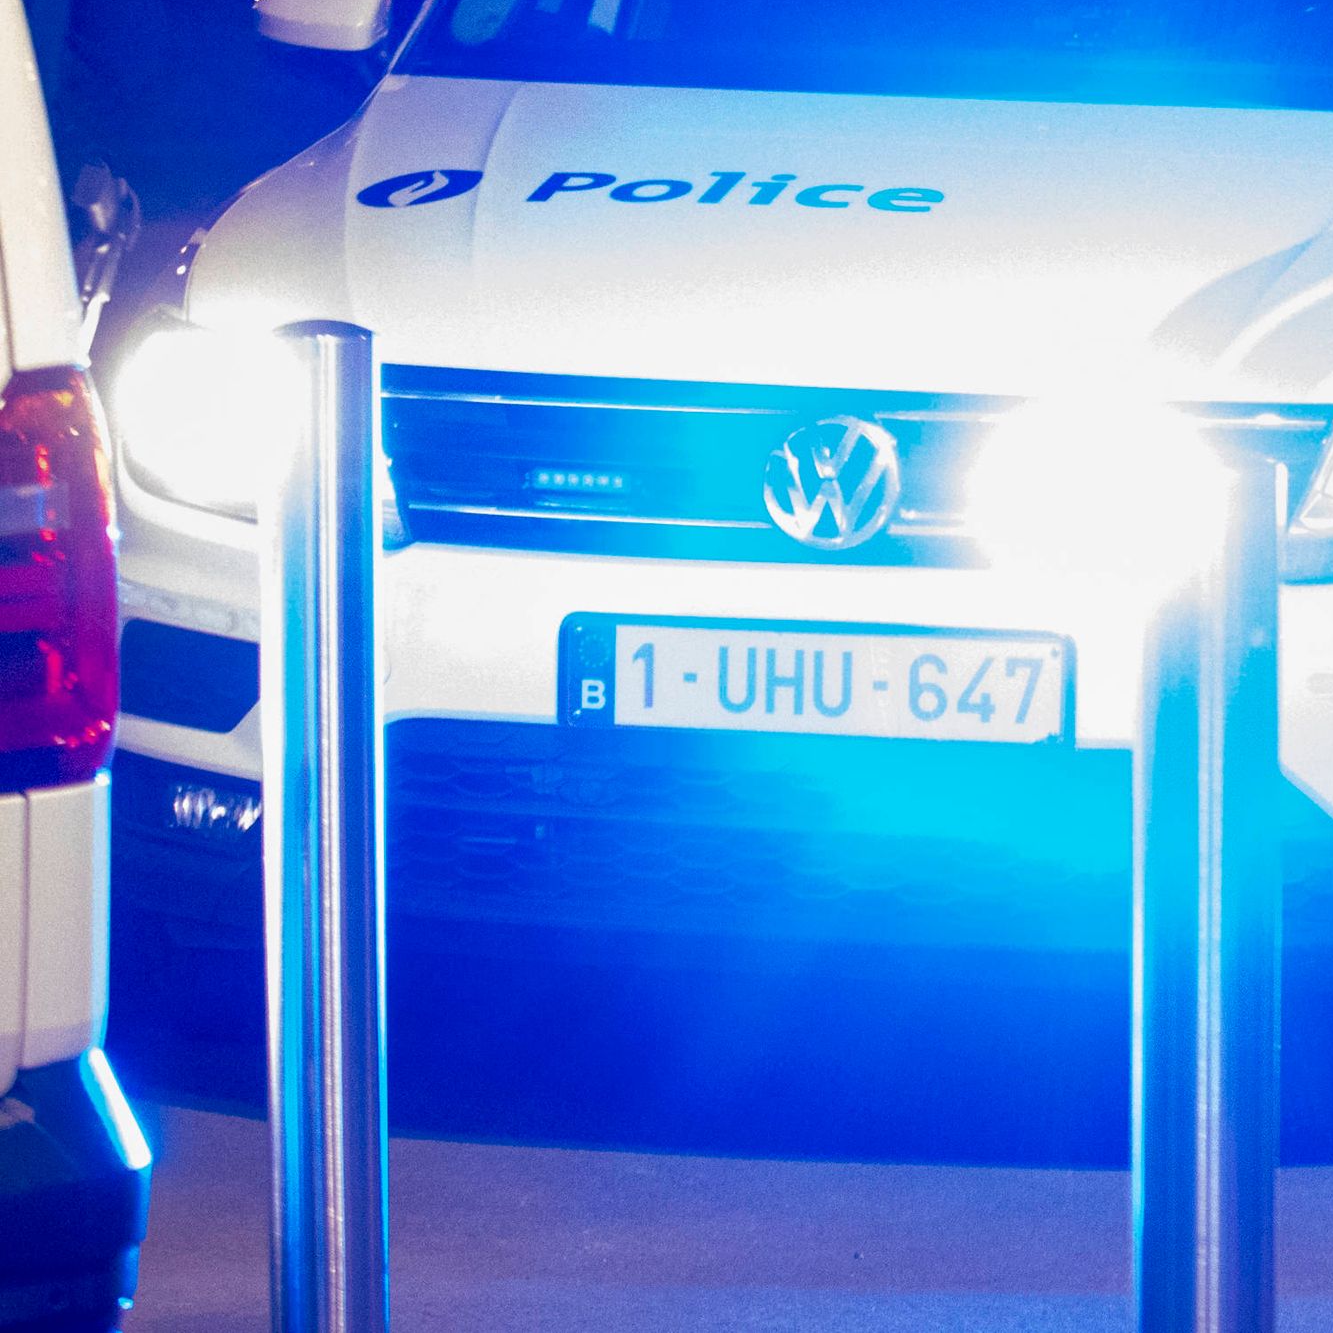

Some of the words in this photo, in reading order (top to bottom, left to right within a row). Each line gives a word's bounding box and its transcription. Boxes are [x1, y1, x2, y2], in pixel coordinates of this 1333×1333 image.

[526, 171, 945, 213] Police
[580, 679, 606, 710] B
[631, 641, 1044, 726] 1-UHU-647
